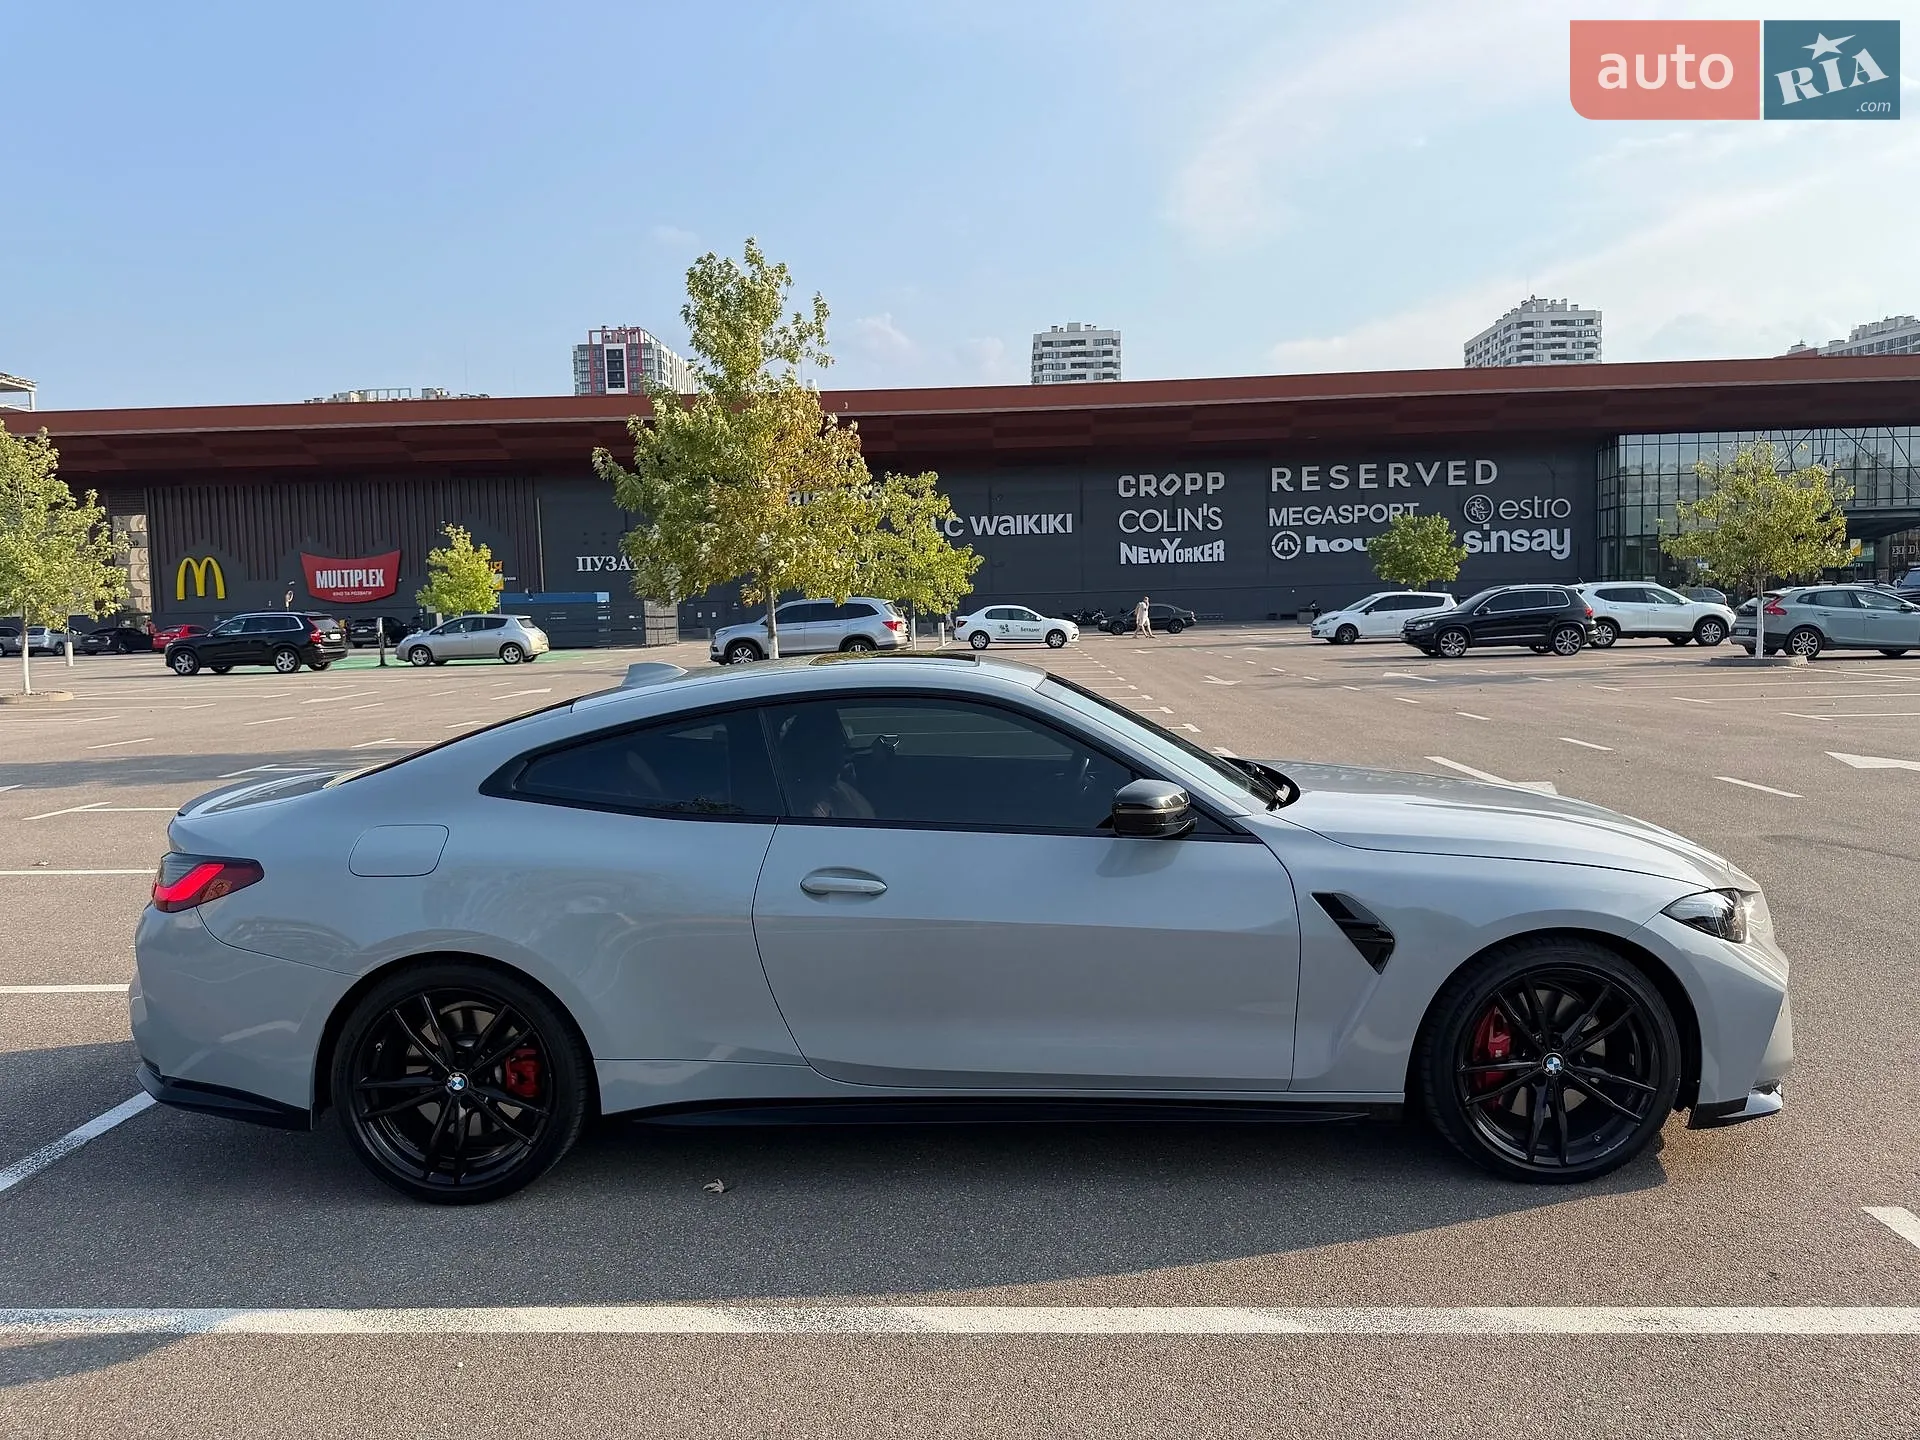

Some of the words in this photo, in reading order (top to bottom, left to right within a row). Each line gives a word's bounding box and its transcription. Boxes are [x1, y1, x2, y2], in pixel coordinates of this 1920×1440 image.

[1118, 471, 1225, 498] CROPP
[1270, 459, 1499, 493] RESERVED
[1118, 503, 1223, 534] COLIN'S
[1268, 502, 1420, 527] MEGASPORT
[1498, 495, 1572, 520] estro
[1305, 535, 1374, 553] hou
[1462, 523, 1571, 561] sinsay
[315, 568, 385, 589] MULTIPLEX
